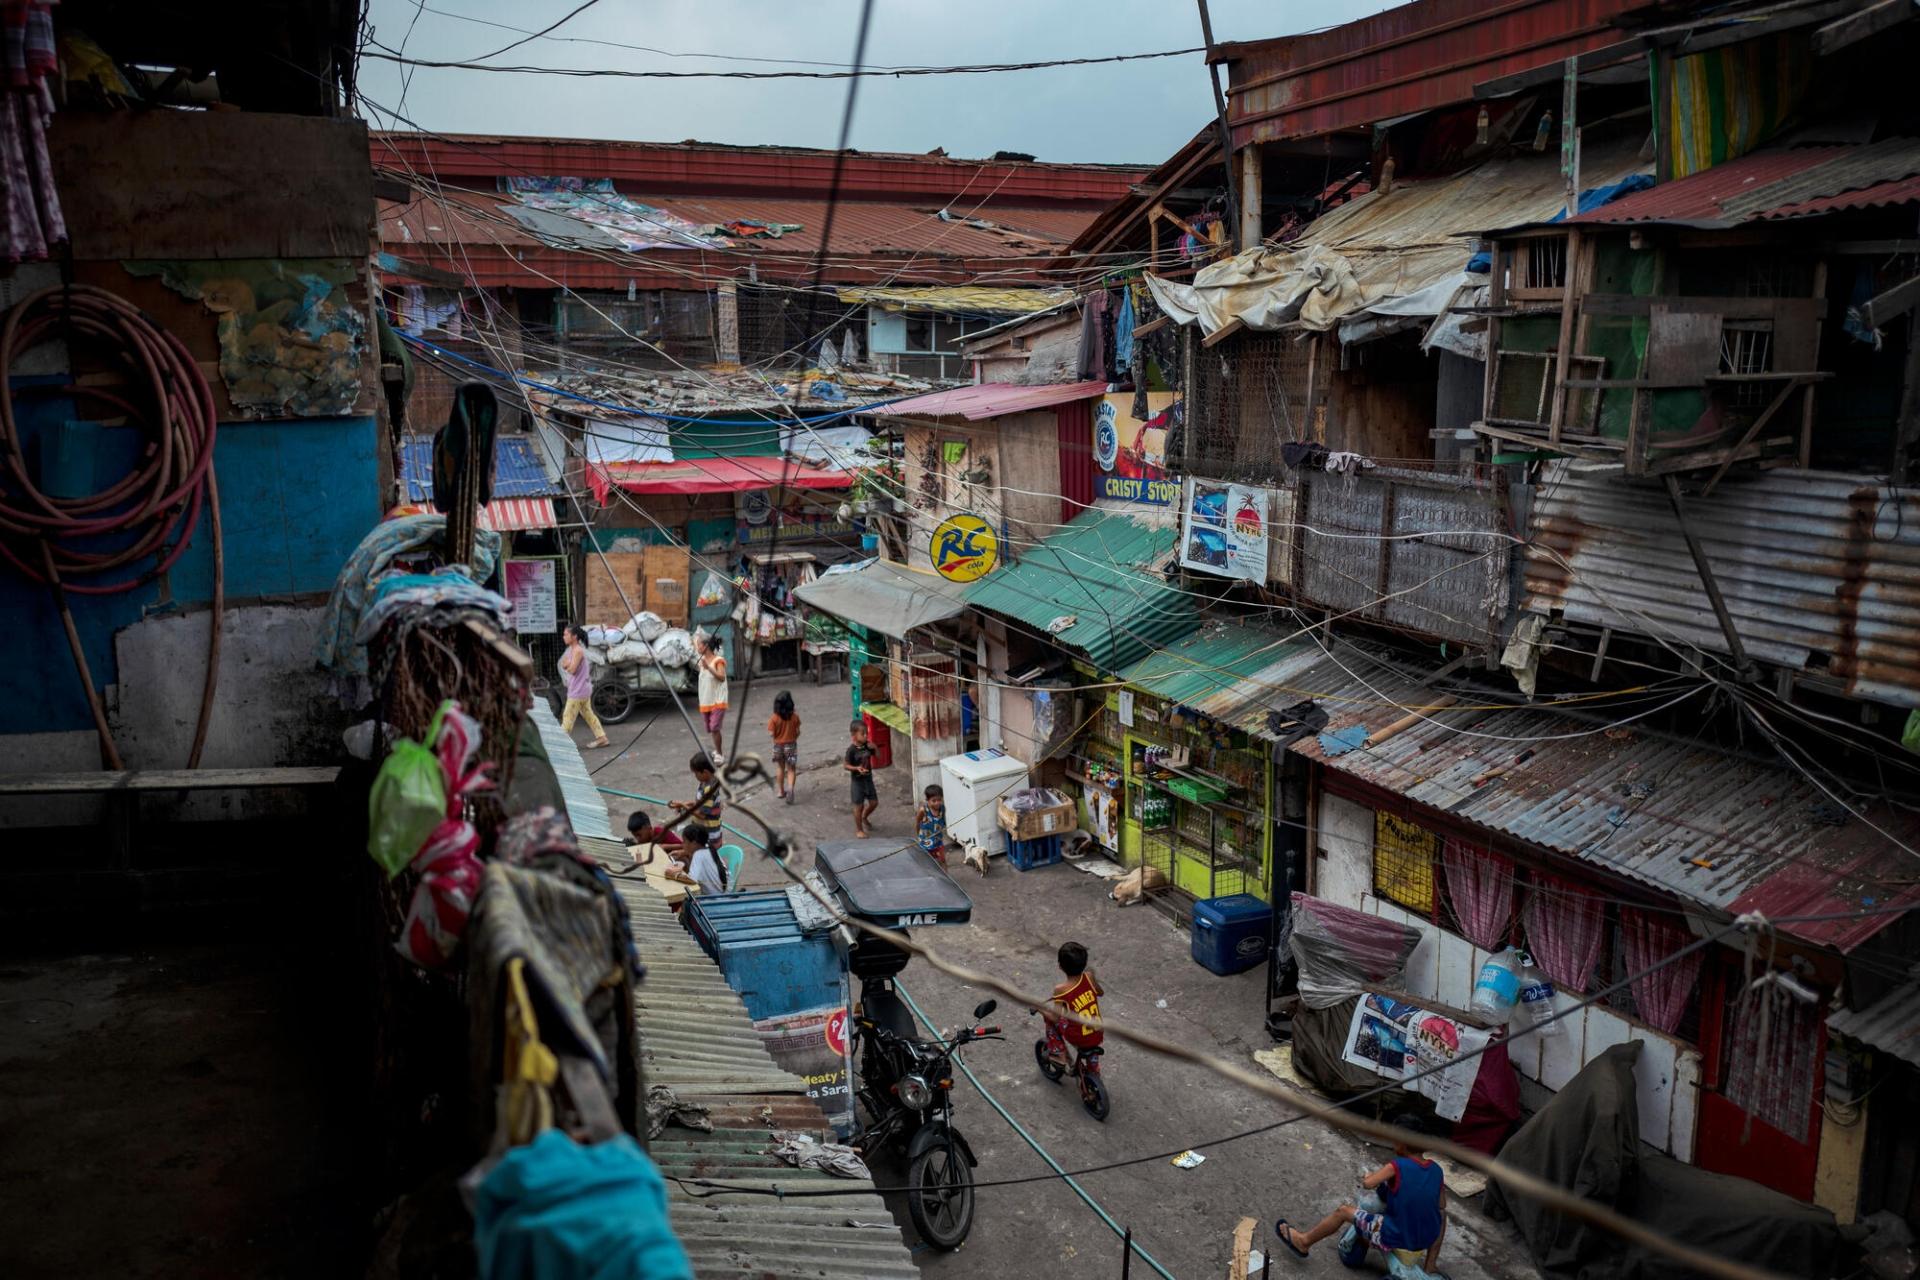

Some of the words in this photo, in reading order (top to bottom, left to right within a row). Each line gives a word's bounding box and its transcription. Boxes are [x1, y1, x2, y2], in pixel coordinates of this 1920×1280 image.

[1105, 478, 1143, 498] CRISTY
[938, 527, 986, 566] RC
[967, 560, 984, 570] cola
[898, 913, 938, 926] MAE
